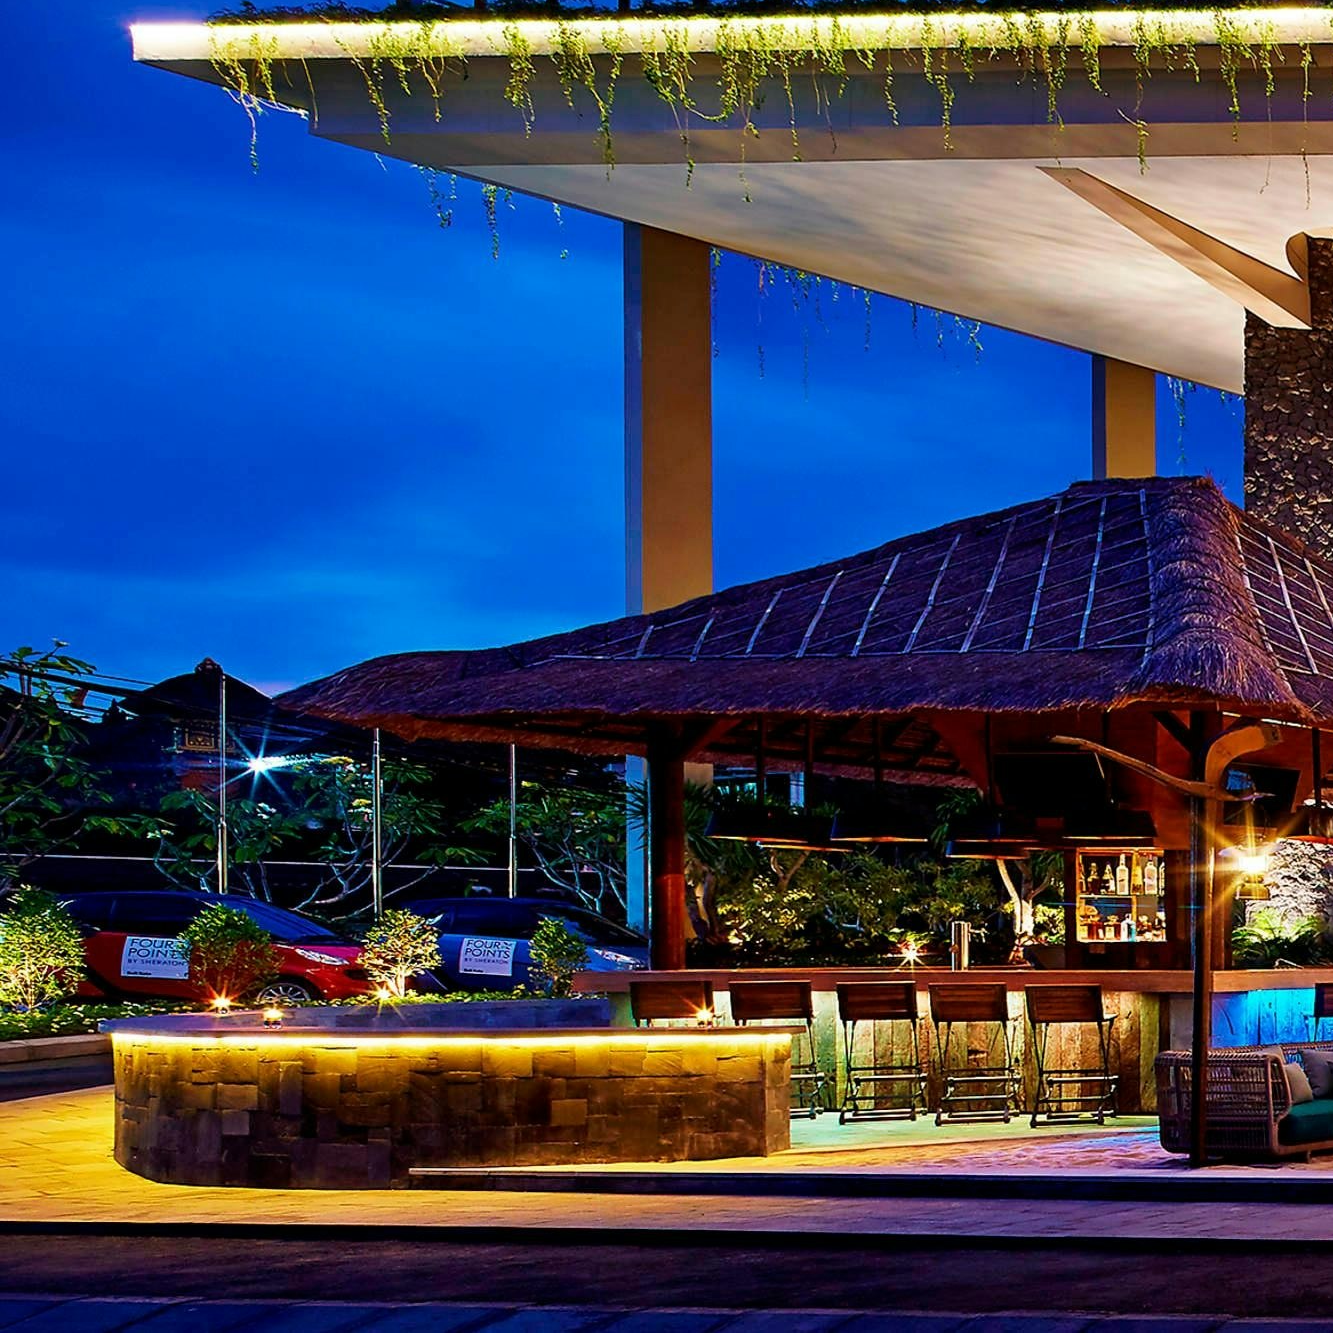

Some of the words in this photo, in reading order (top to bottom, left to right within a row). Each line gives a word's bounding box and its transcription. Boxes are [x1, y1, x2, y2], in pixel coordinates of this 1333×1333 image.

[131, 938, 174, 949] FOUR
[466, 939, 501, 949] FOUR
[464, 948, 510, 959] POINTS
